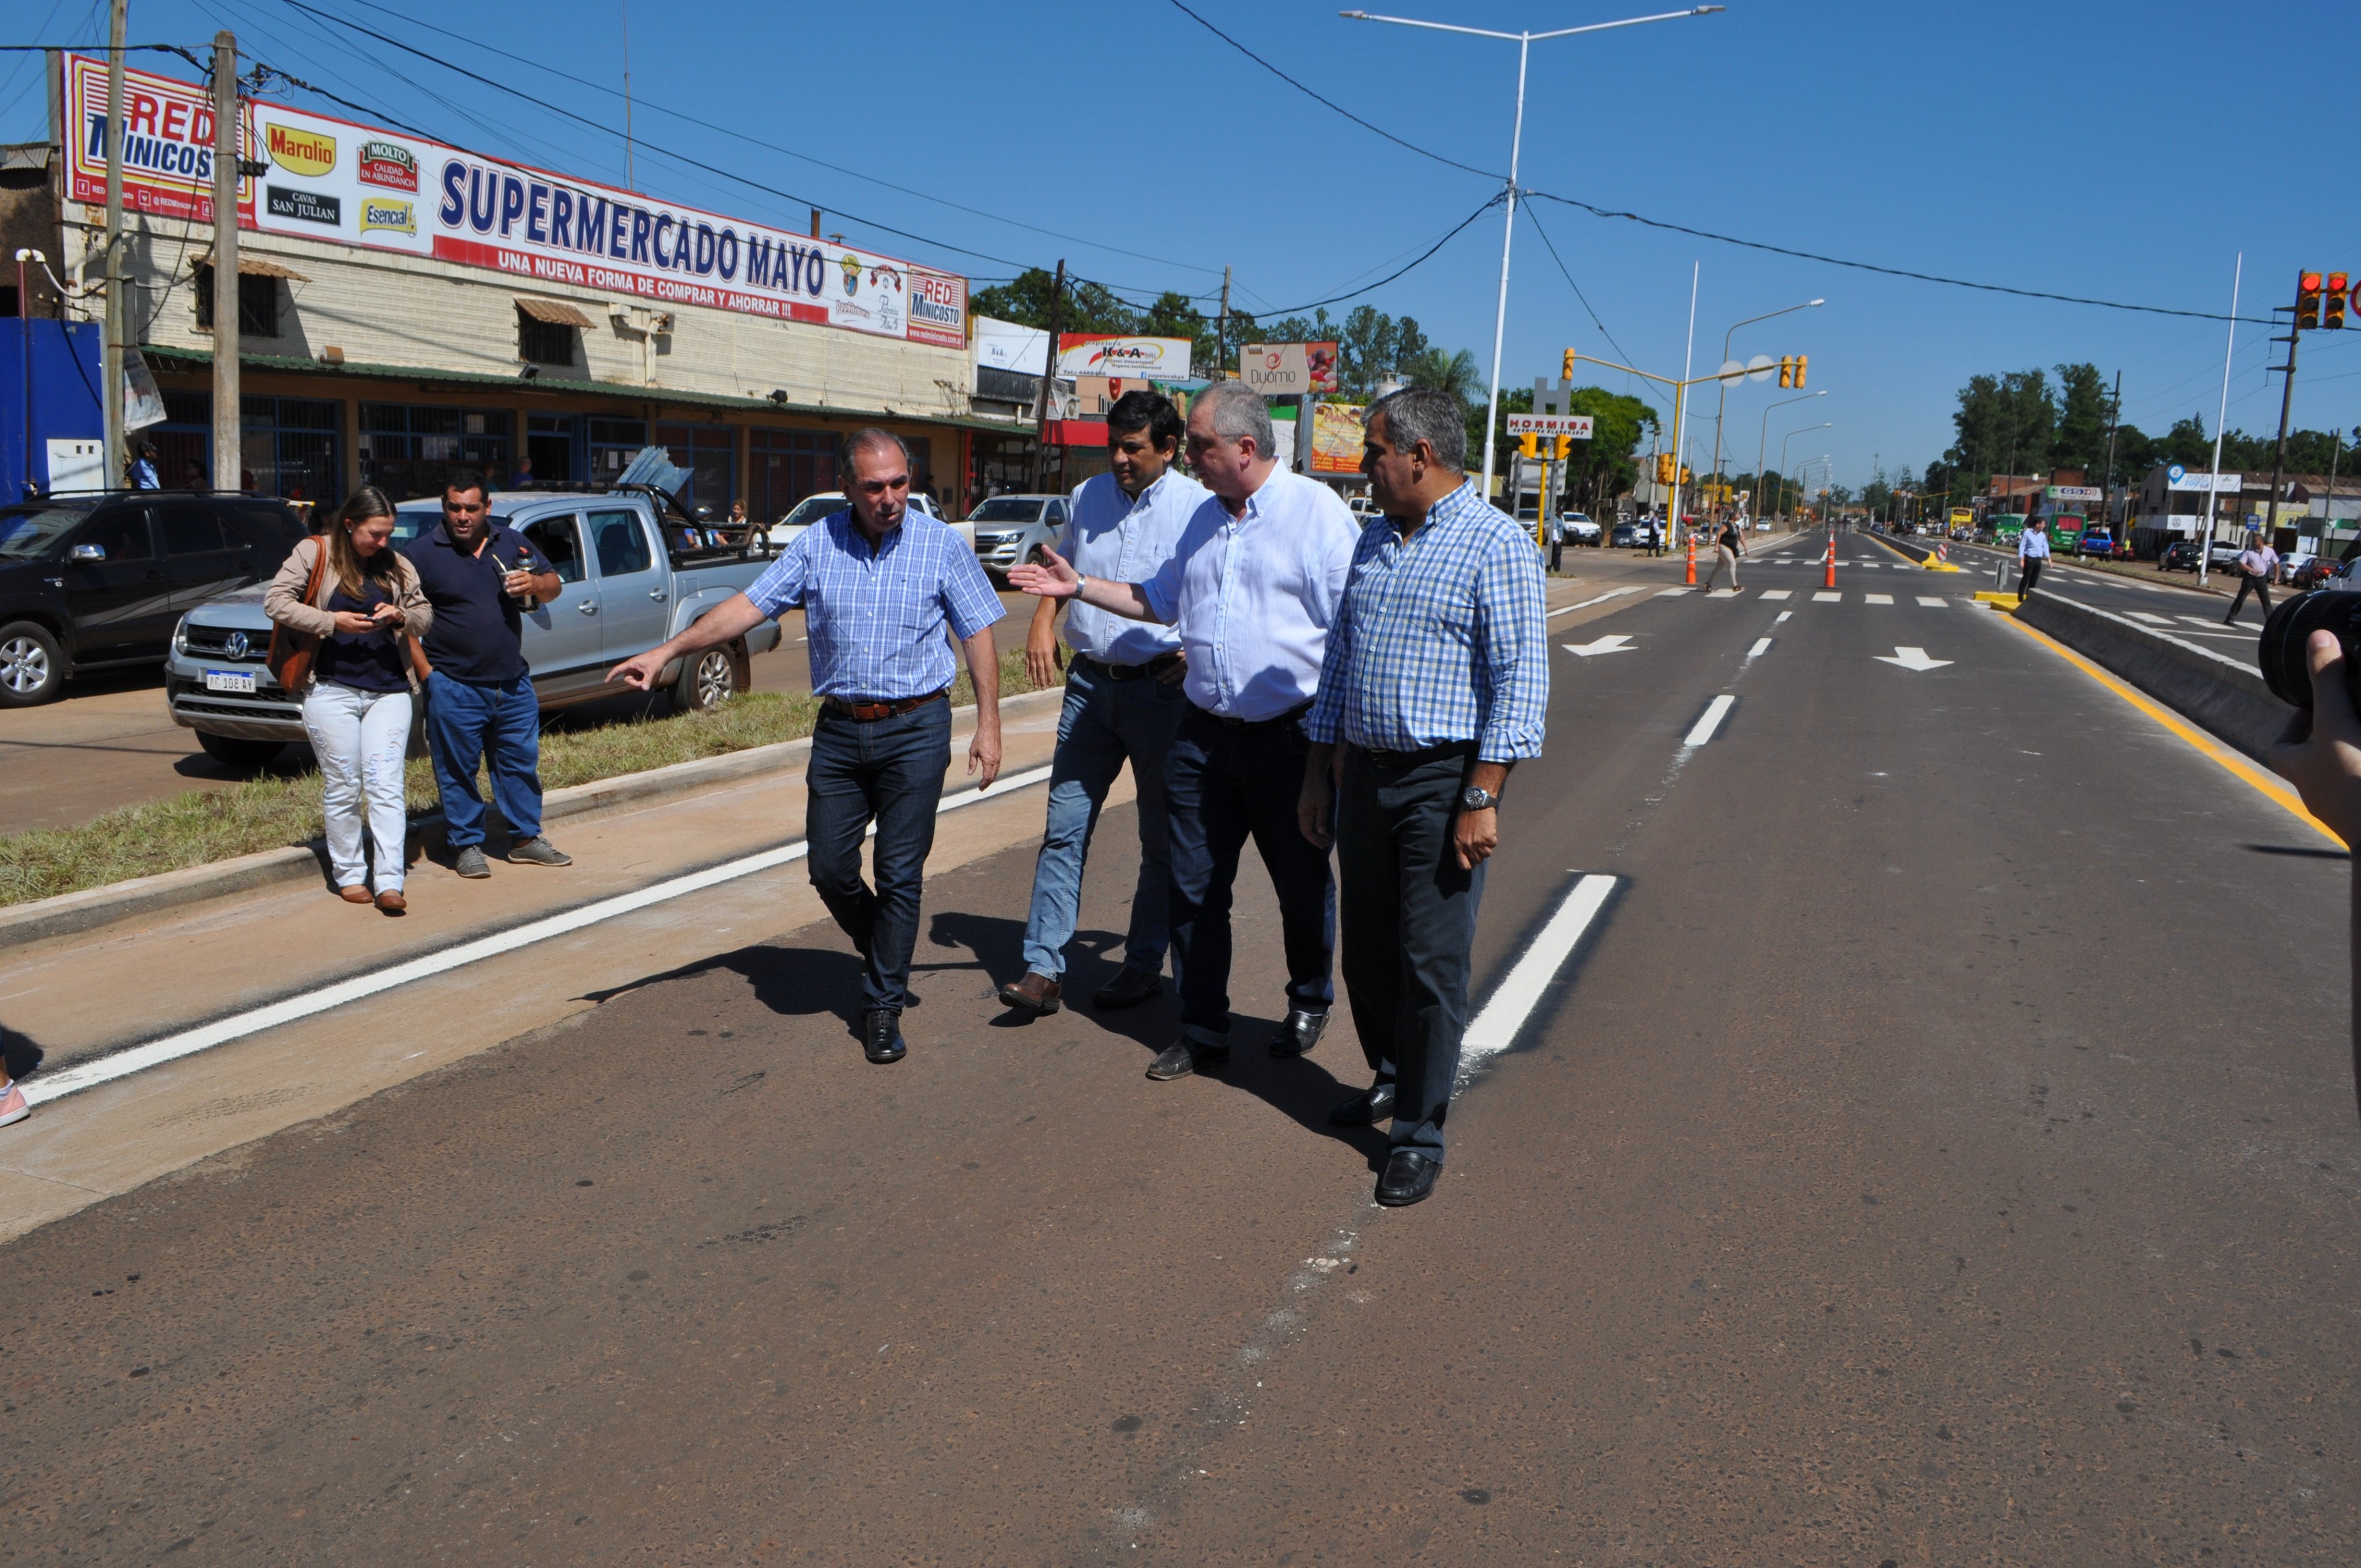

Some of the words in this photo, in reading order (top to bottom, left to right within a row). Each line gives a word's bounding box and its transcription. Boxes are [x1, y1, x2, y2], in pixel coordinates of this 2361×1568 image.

[130, 94, 215, 149] RED
[86, 112, 231, 180] MINICOS
[270, 127, 332, 164] Marolio
[371, 144, 407, 162] MOLTO
[361, 169, 371, 178] EN
[372, 172, 416, 188] ABUNDANCIA
[374, 163, 403, 176] CALIDAD
[92, 184, 106, 194] RED
[292, 193, 316, 205] CAVAS
[273, 199, 294, 213] SAN
[297, 203, 335, 221] JULIAN
[367, 205, 408, 225] Esencial
[439, 159, 739, 282] SUPERMERCADO
[745, 231, 825, 299] MAYO
[498, 250, 531, 273] UNA
[535, 258, 584, 282] NUEVA
[588, 267, 634, 292] FORMA
[638, 276, 654, 295] DE
[657, 280, 715, 305] COMPRAR
[717, 290, 726, 306] Y
[727, 293, 779, 316] AHORRAR
[924, 280, 953, 306] RED
[911, 292, 959, 325] MINICOSTO
[1509, 419, 1589, 431] HORMISA
[242, 679, 252, 691] AY
